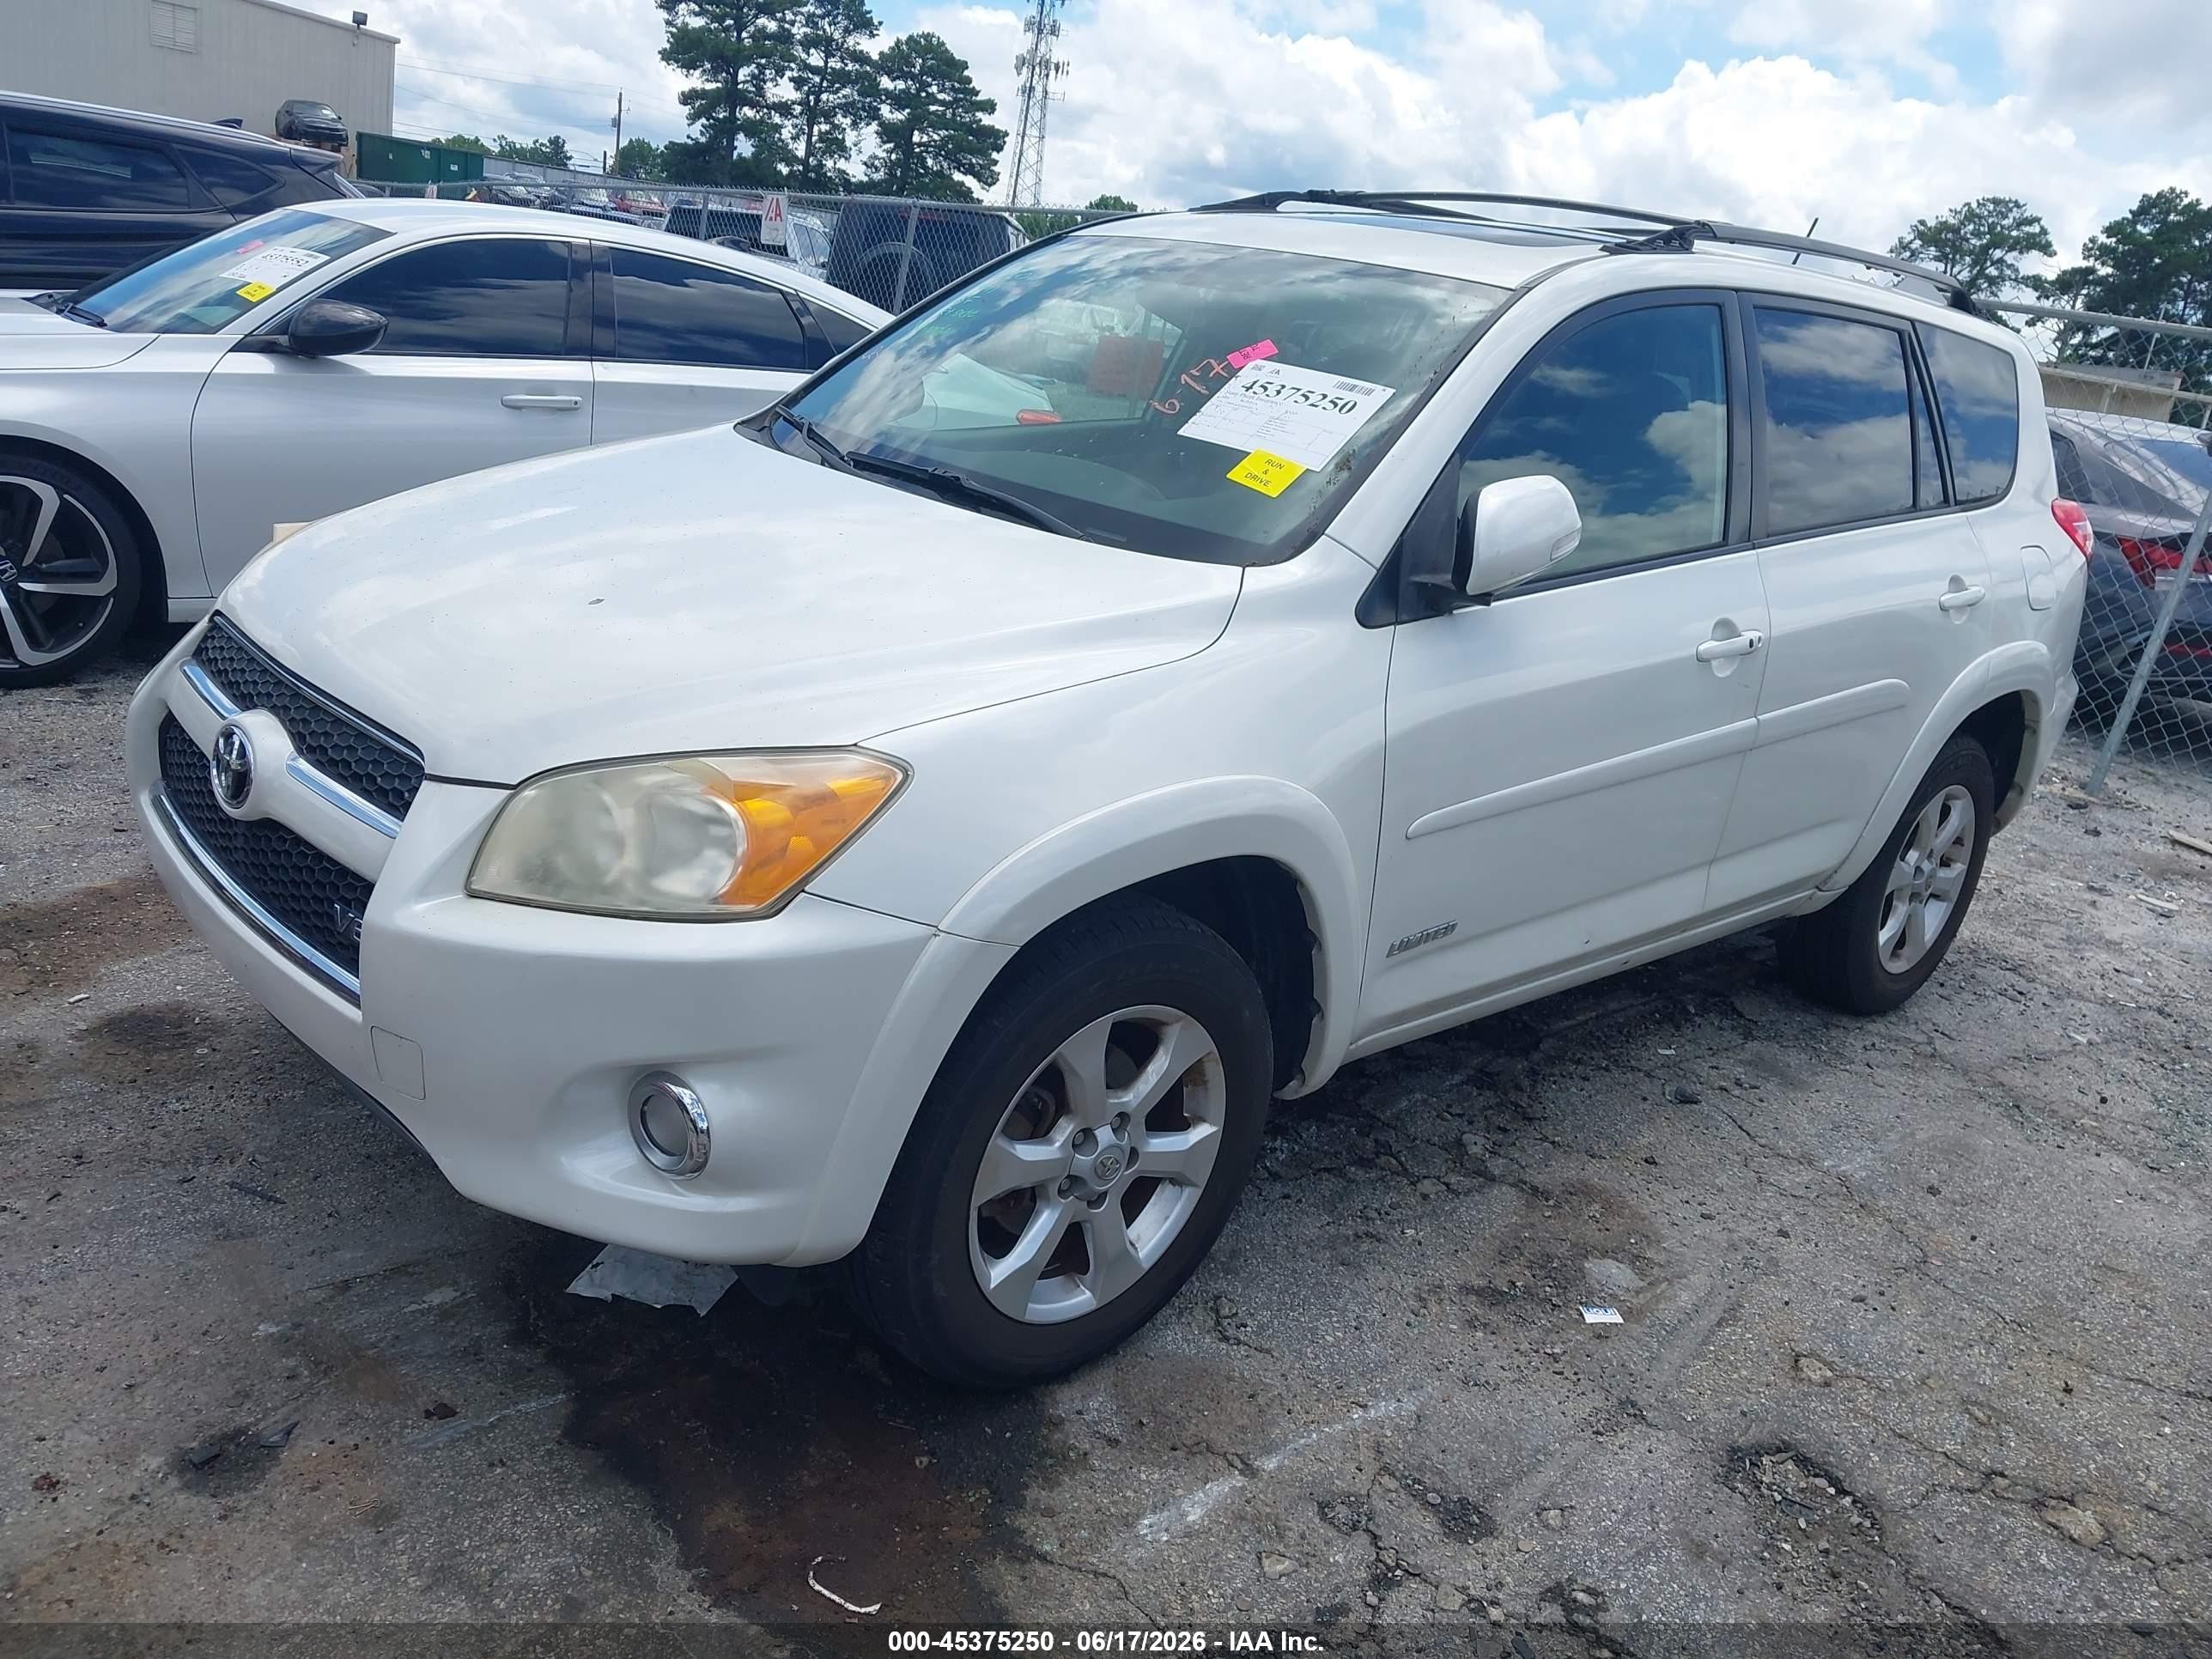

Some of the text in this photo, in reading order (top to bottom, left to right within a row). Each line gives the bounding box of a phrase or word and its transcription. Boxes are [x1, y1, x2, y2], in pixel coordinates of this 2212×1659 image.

[1242, 379, 1358, 415] 45375250
[1265, 459, 1285, 470] RUN
[1244, 472, 1272, 487] DRIVE
[1386, 920, 1458, 958] LIMITED
